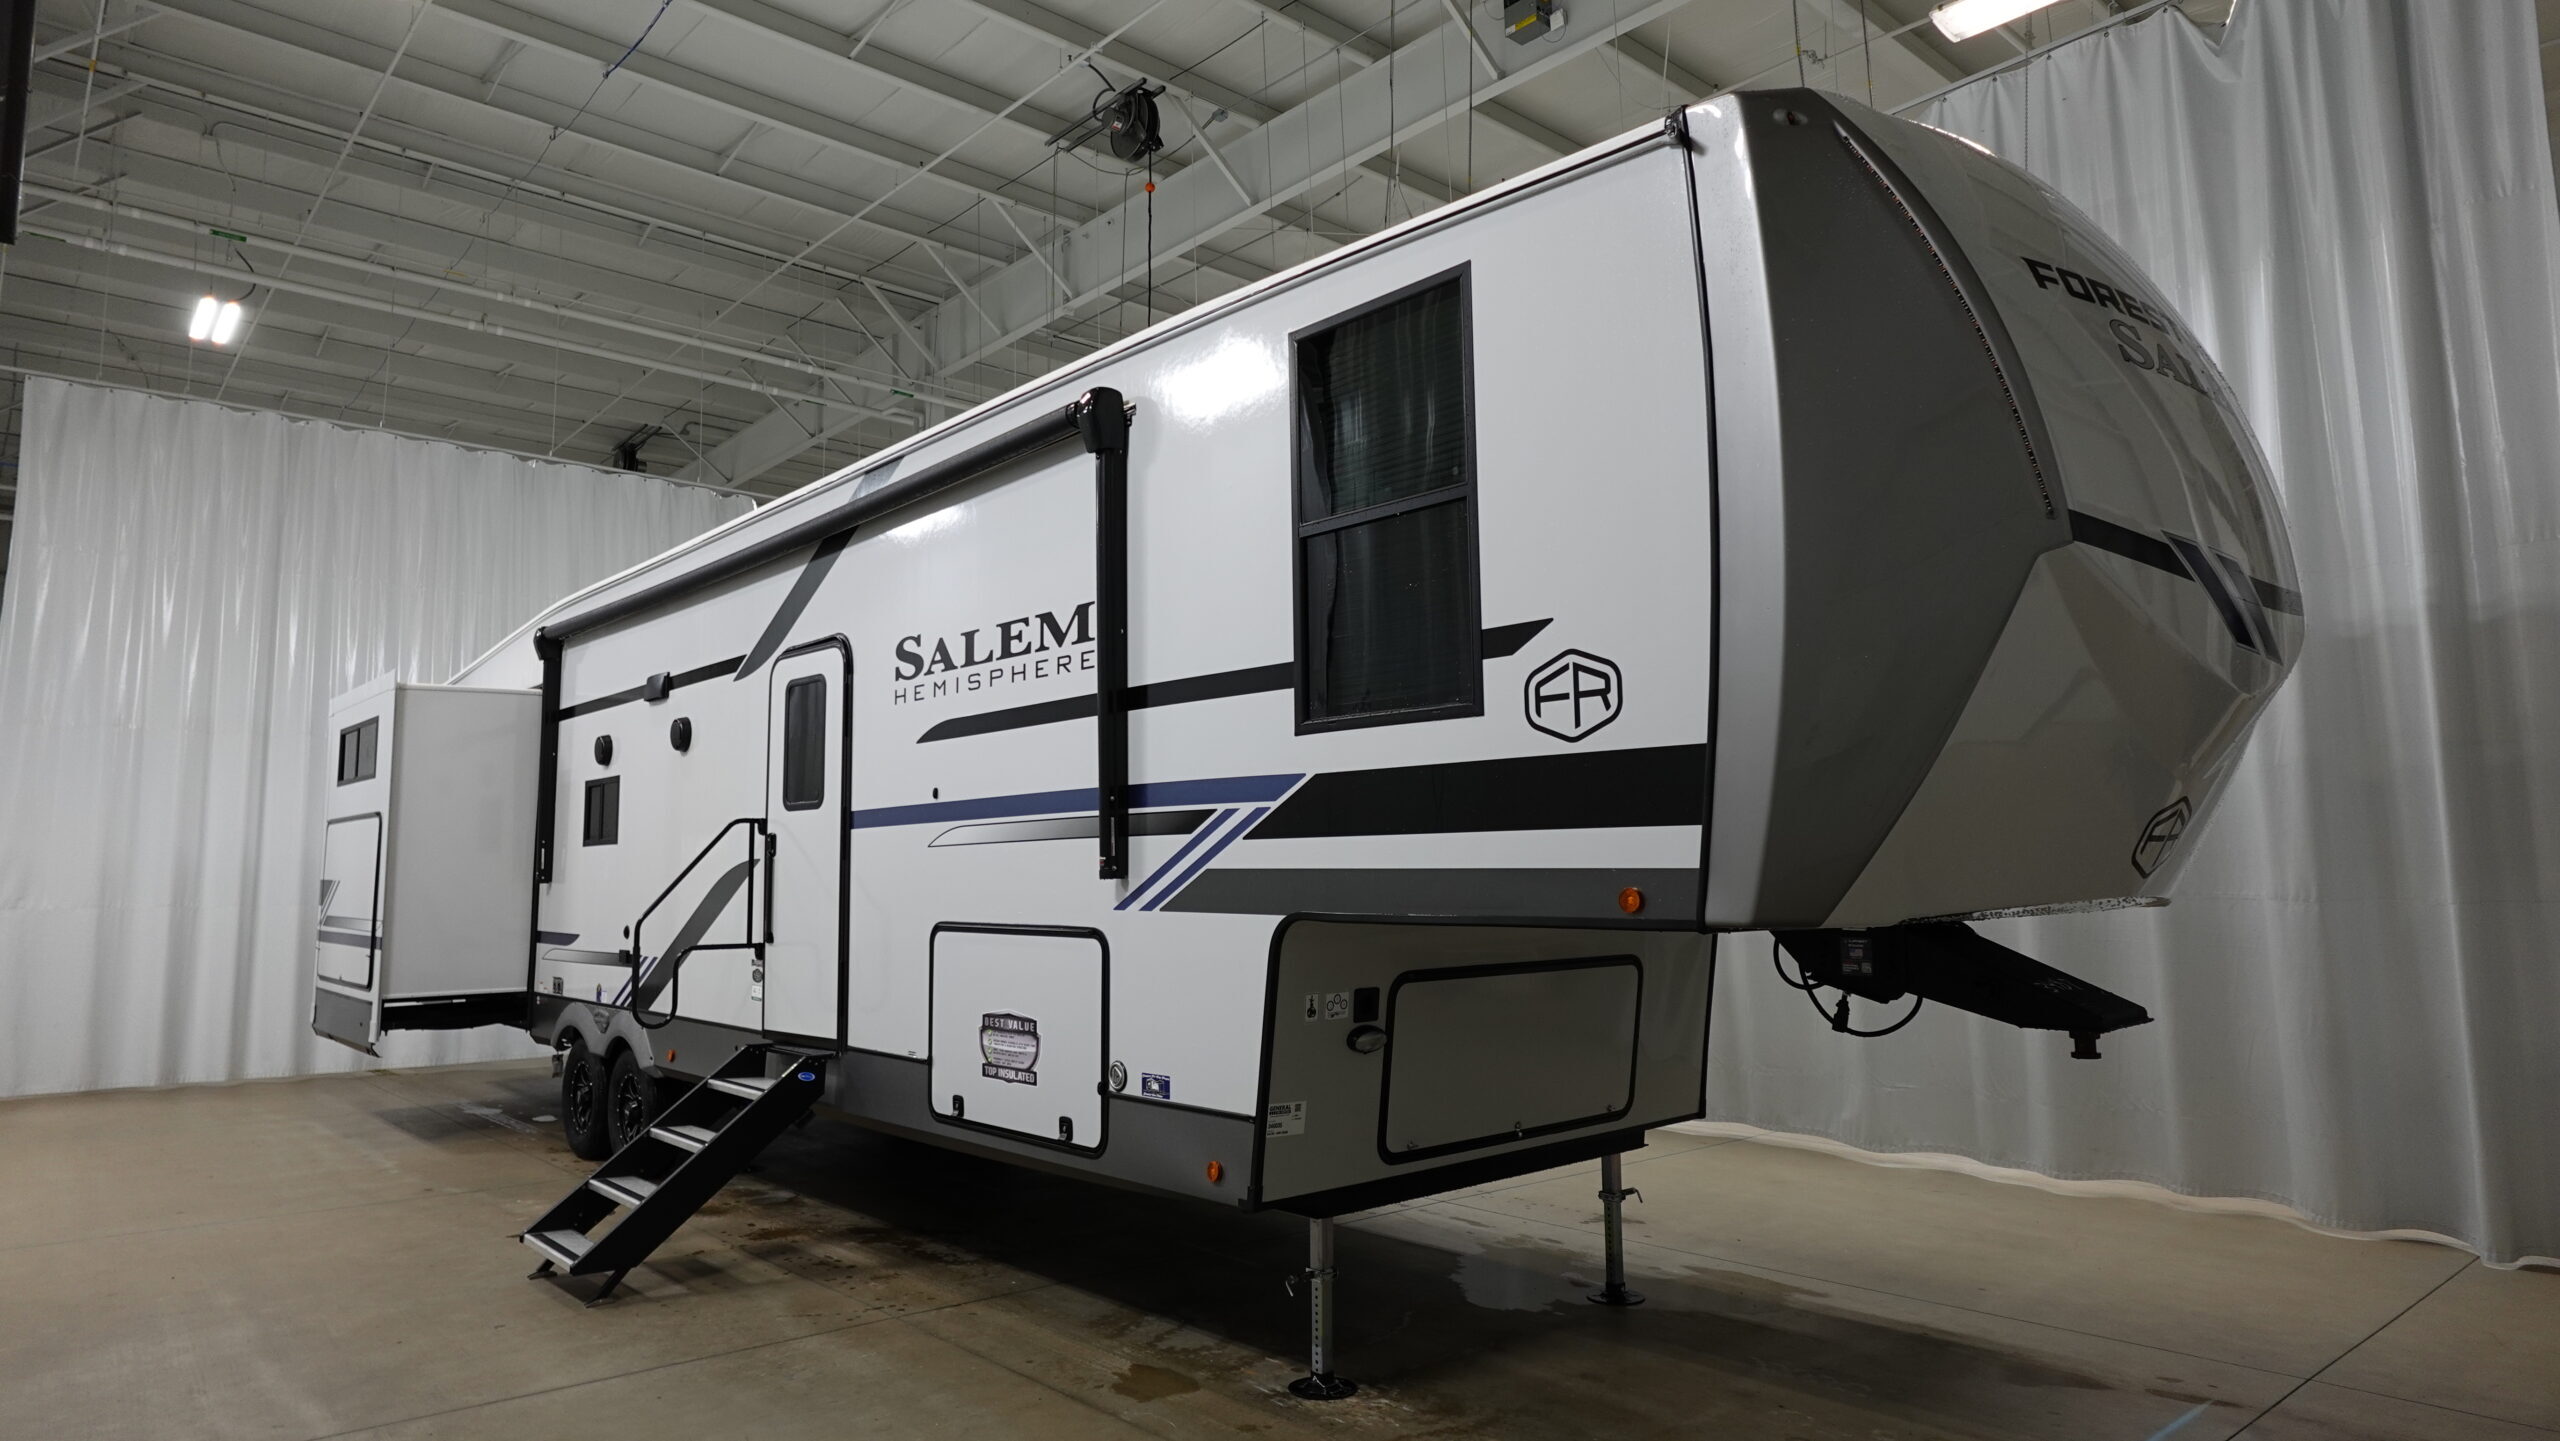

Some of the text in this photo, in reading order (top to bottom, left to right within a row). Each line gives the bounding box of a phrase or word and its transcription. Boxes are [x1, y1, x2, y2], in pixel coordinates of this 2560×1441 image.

[2108, 318, 2211, 396] SAL
[894, 601, 1095, 682] SALEM
[894, 650, 1095, 705] HEMISPHERE
[985, 1017, 1035, 1031] BEST VALUE
[985, 1066, 1035, 1083] TOP INSULATED
